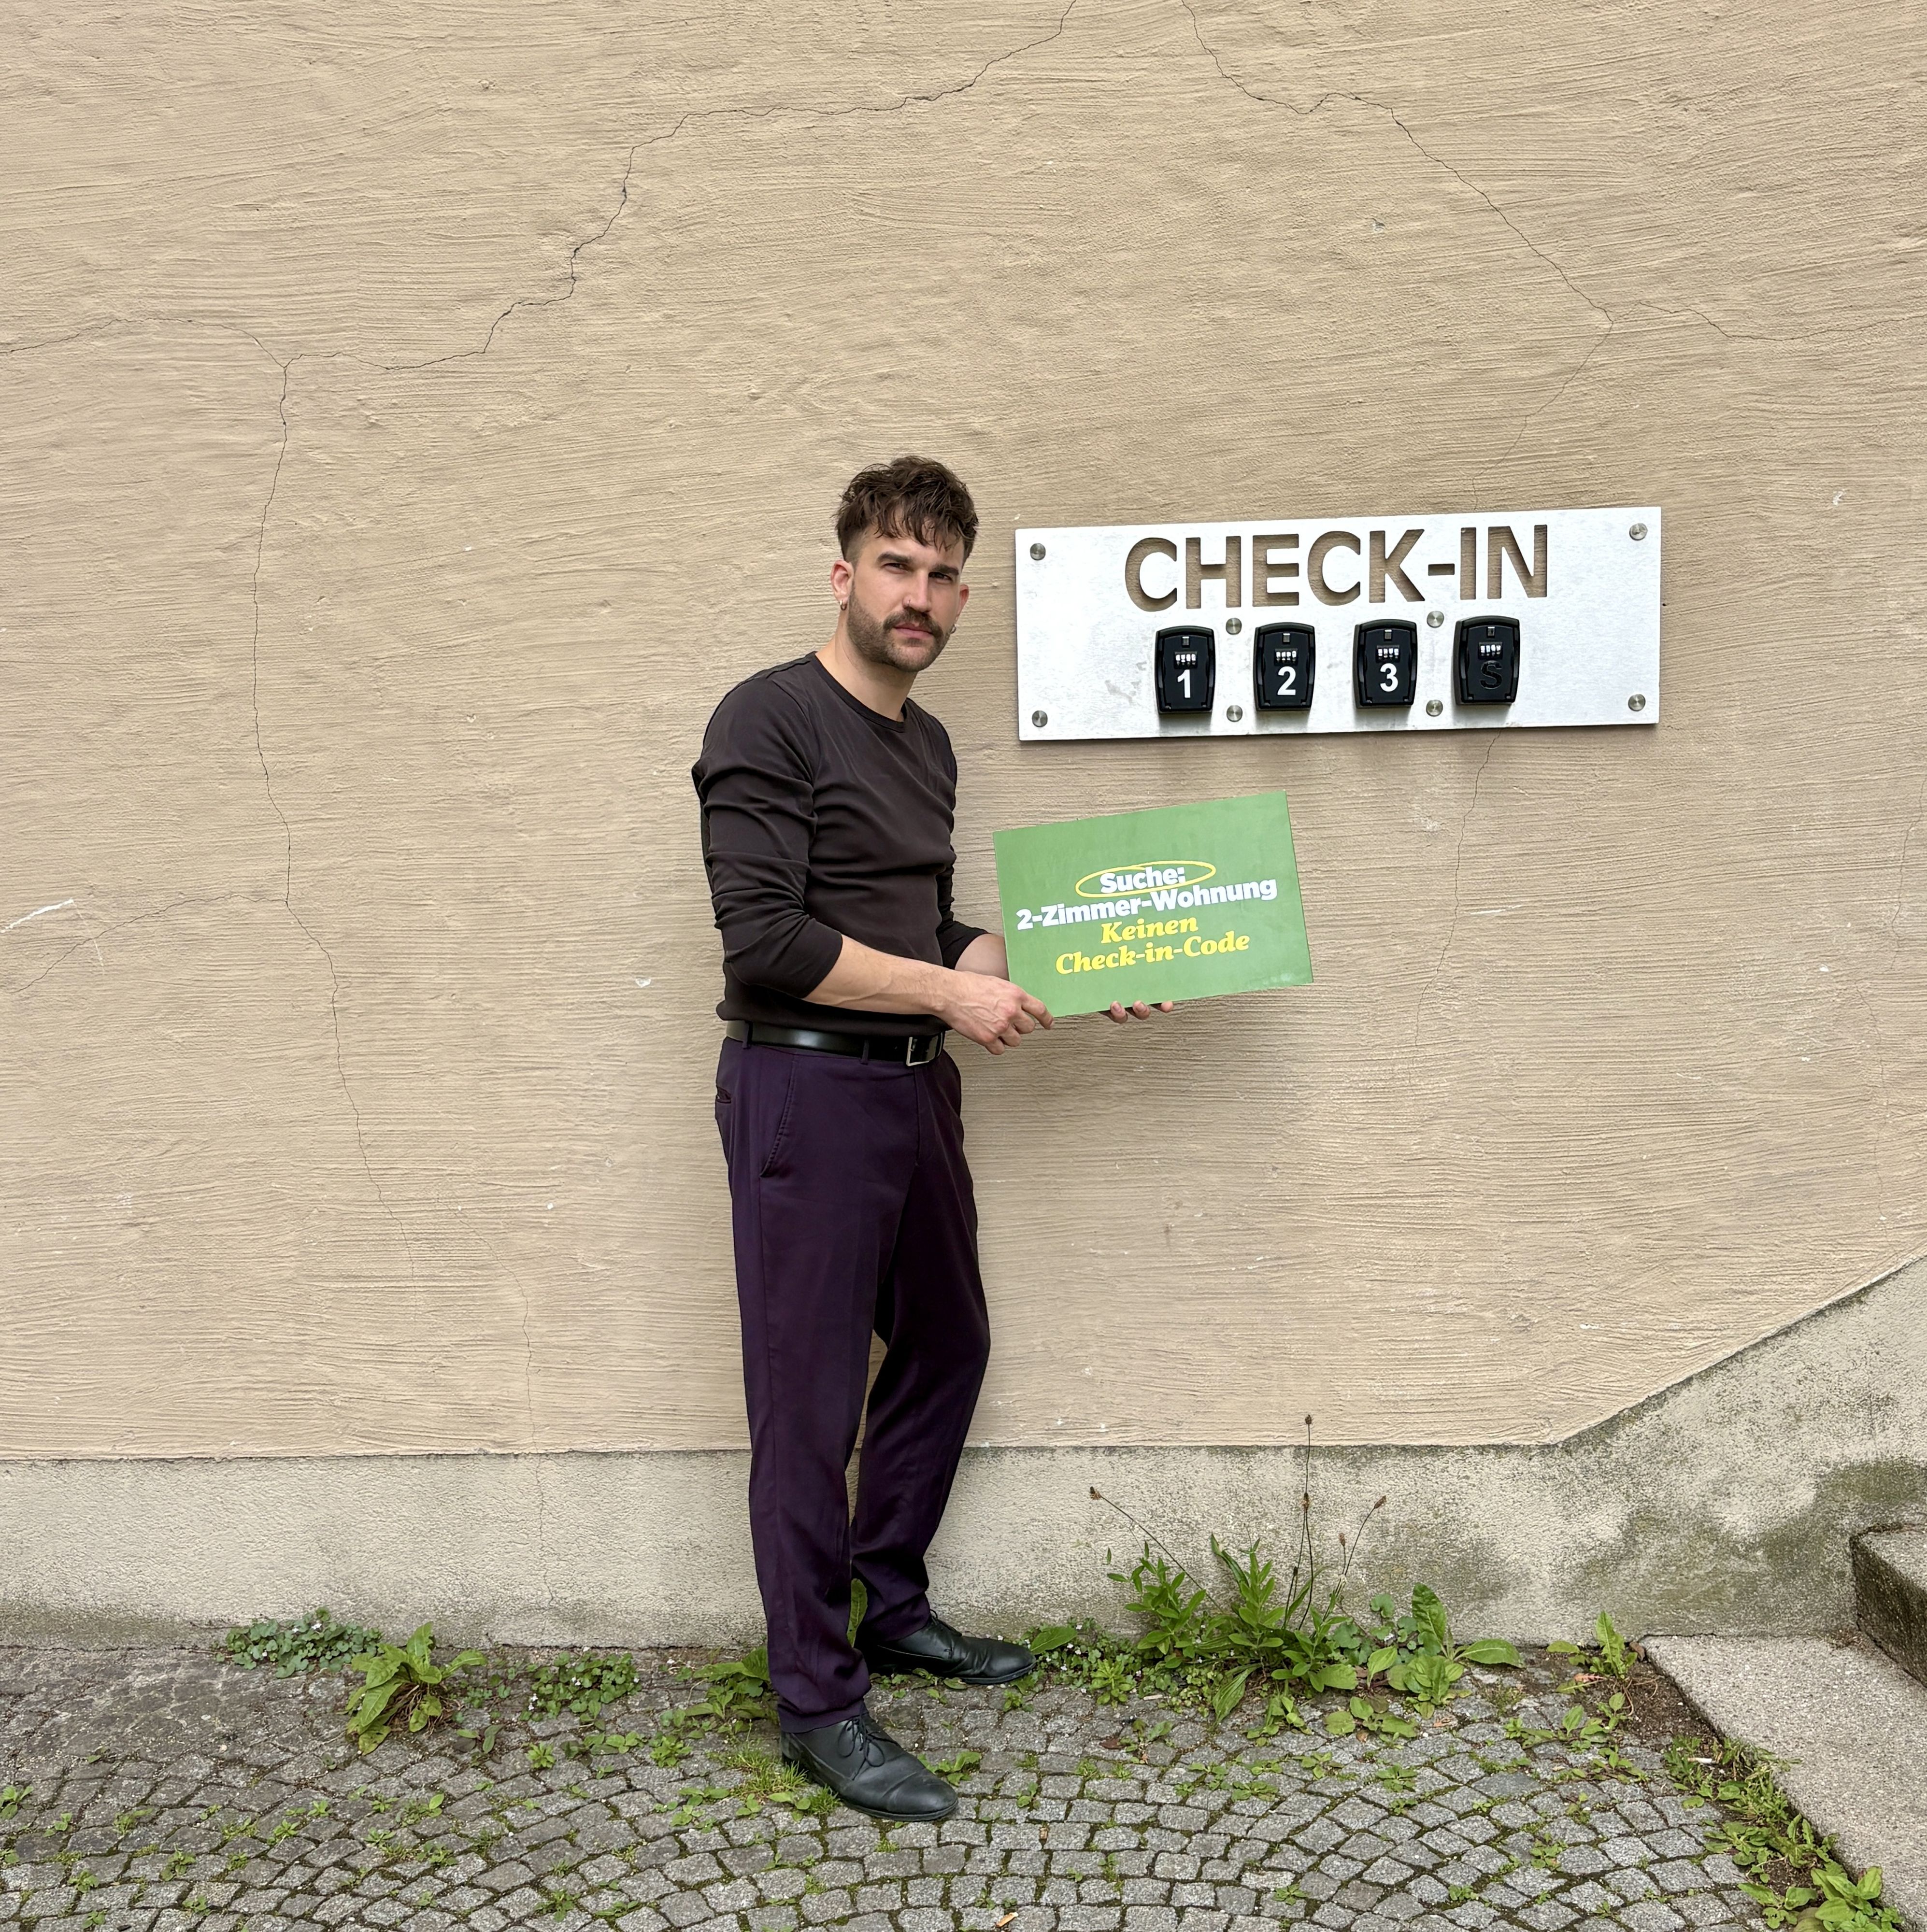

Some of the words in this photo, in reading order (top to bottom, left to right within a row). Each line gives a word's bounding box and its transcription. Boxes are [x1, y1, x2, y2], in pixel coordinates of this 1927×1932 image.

[1125, 525, 1547, 611] CHECK-IN
[1177, 669, 1191, 698] 1
[1277, 666, 1296, 695] 2
[1380, 663, 1399, 692] 3
[1479, 660, 1502, 689] S
[1100, 867, 1185, 893] Suche:
[1016, 879, 1277, 930] 2-Zimmer-Wohnung
[1101, 917, 1198, 943] Keinen
[1056, 931, 1250, 974] Check-in-Code
